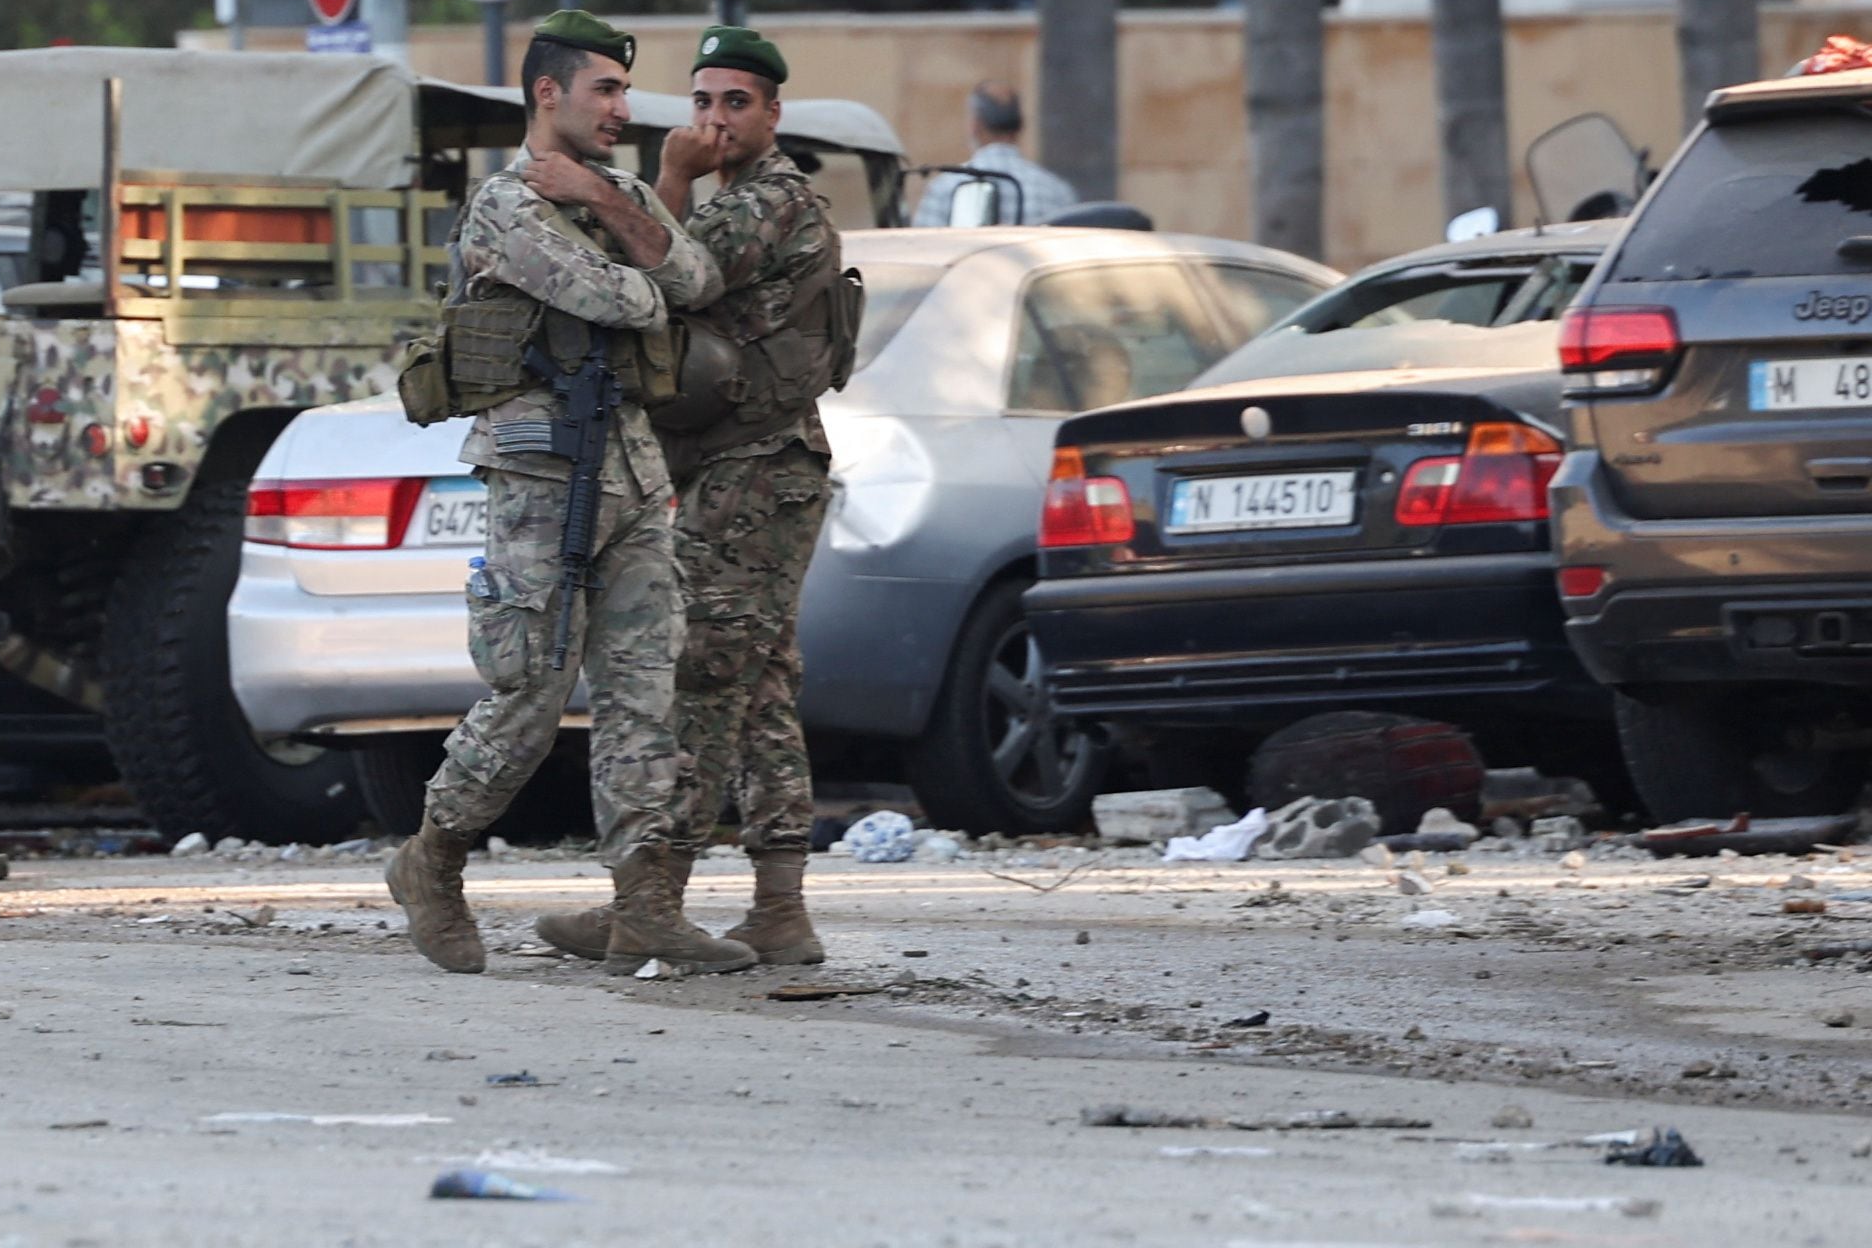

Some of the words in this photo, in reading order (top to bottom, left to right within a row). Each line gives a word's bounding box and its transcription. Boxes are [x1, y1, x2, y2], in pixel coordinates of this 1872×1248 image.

[1794, 290, 1872, 324] Jeep
[1774, 366, 1797, 403] M
[1193, 484, 1214, 520] N
[1232, 478, 1334, 518] 144510
